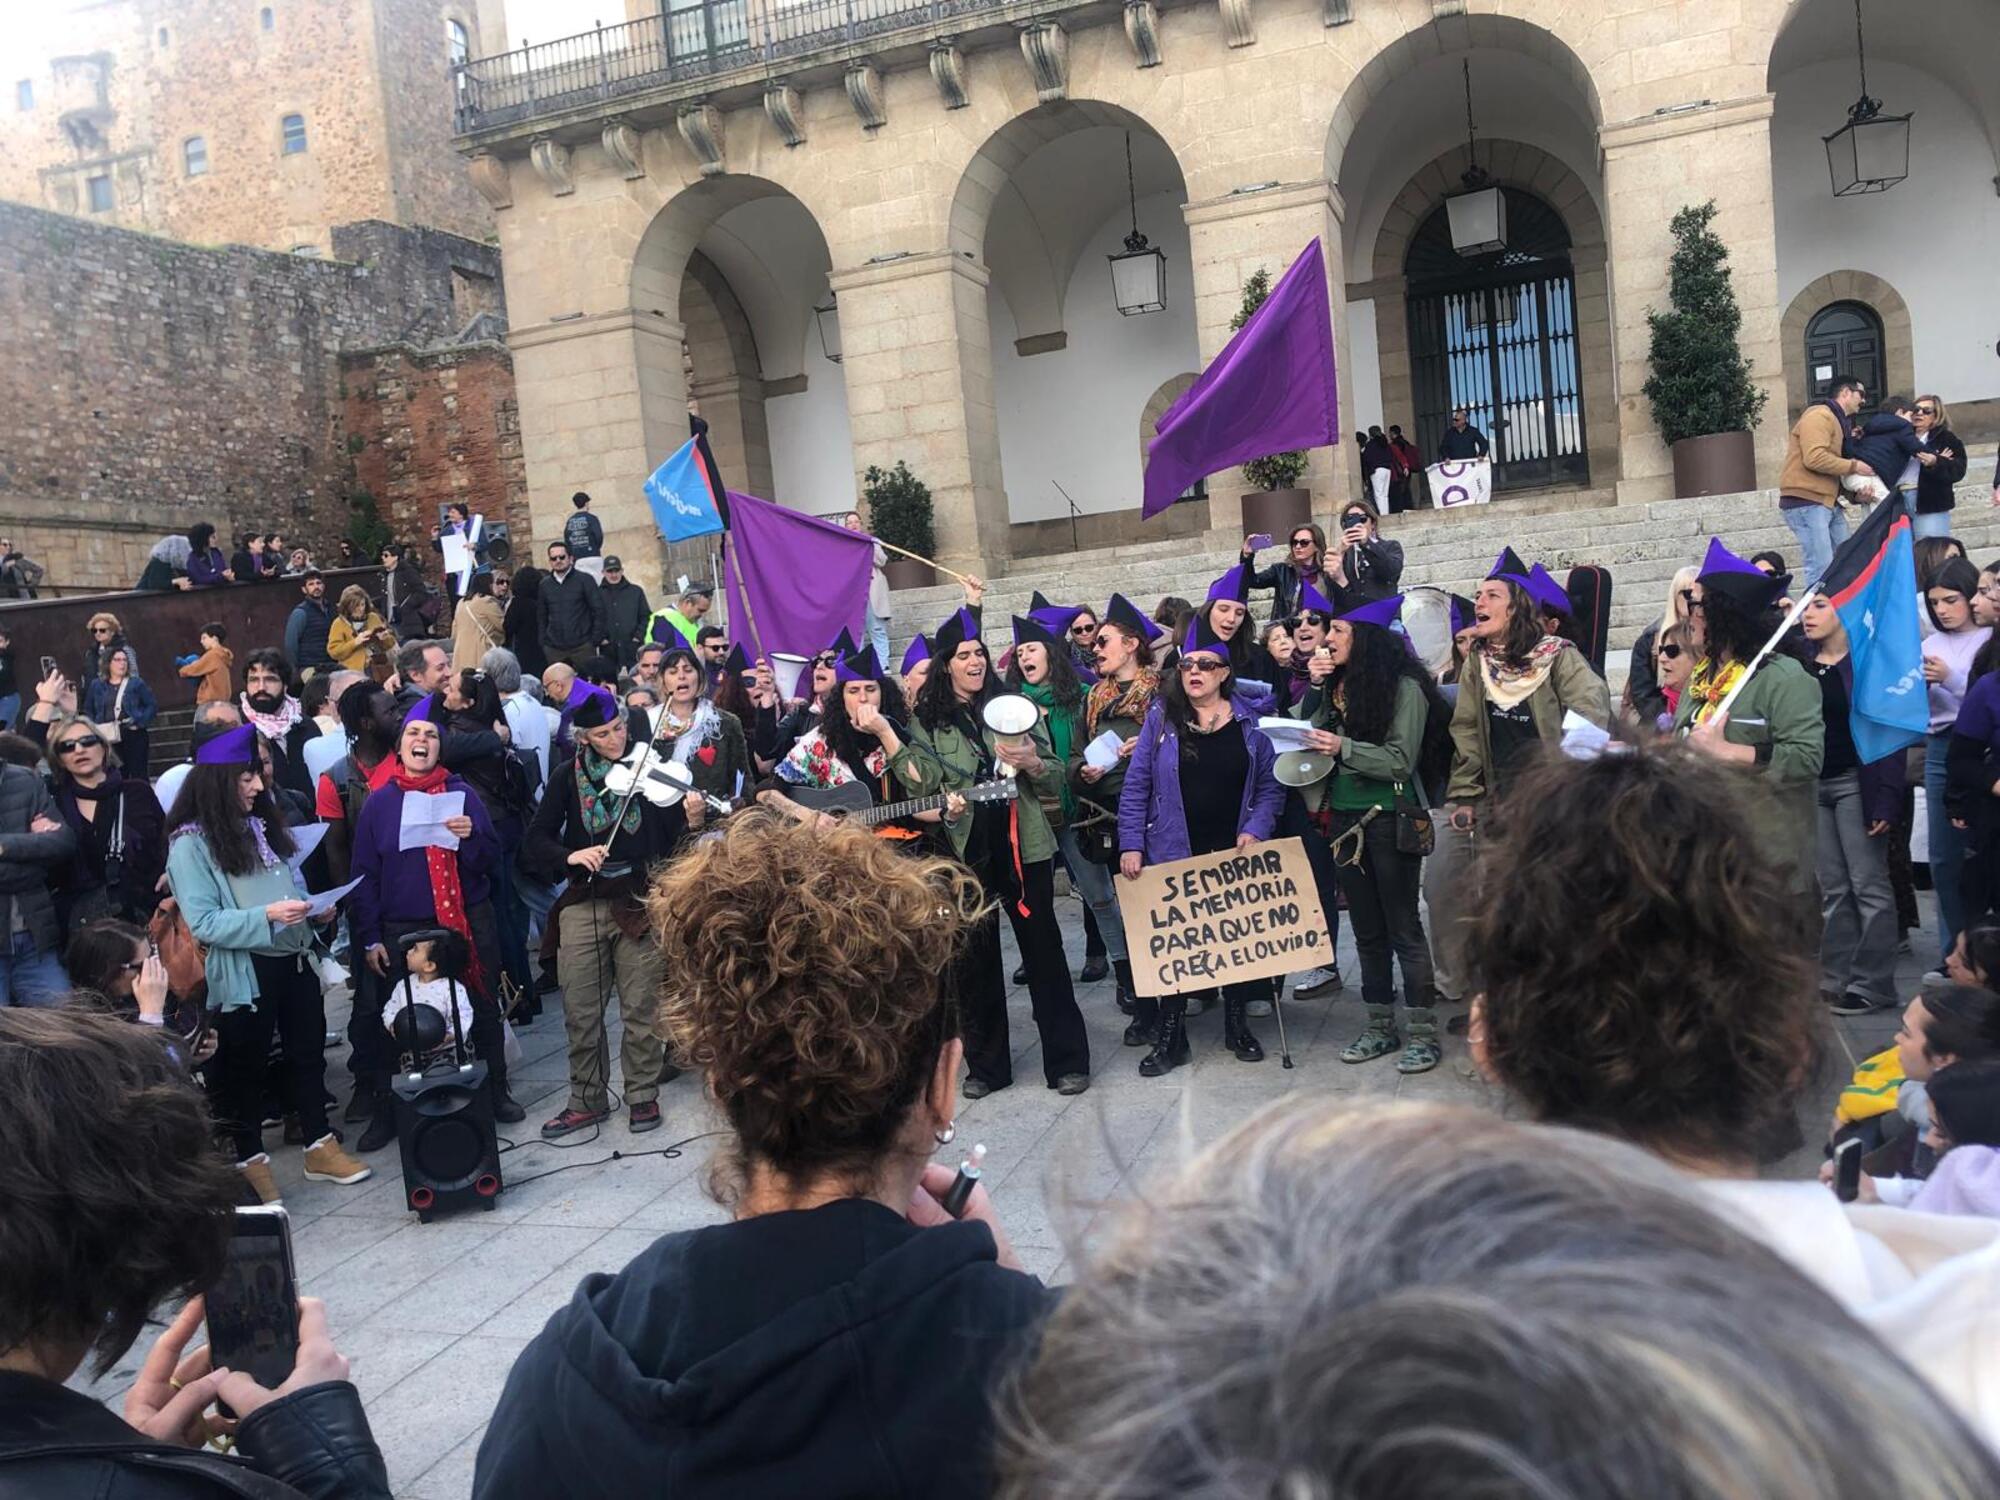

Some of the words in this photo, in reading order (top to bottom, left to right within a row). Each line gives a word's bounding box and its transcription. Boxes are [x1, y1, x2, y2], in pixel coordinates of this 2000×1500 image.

[1162, 850, 1282, 902] SEMBRAR
[1150, 905, 1186, 929] LA
[1150, 923, 1217, 958] PARA
[1219, 911, 1266, 943] QUE
[1268, 902, 1300, 928] NO
[1231, 946, 1256, 966] EL
